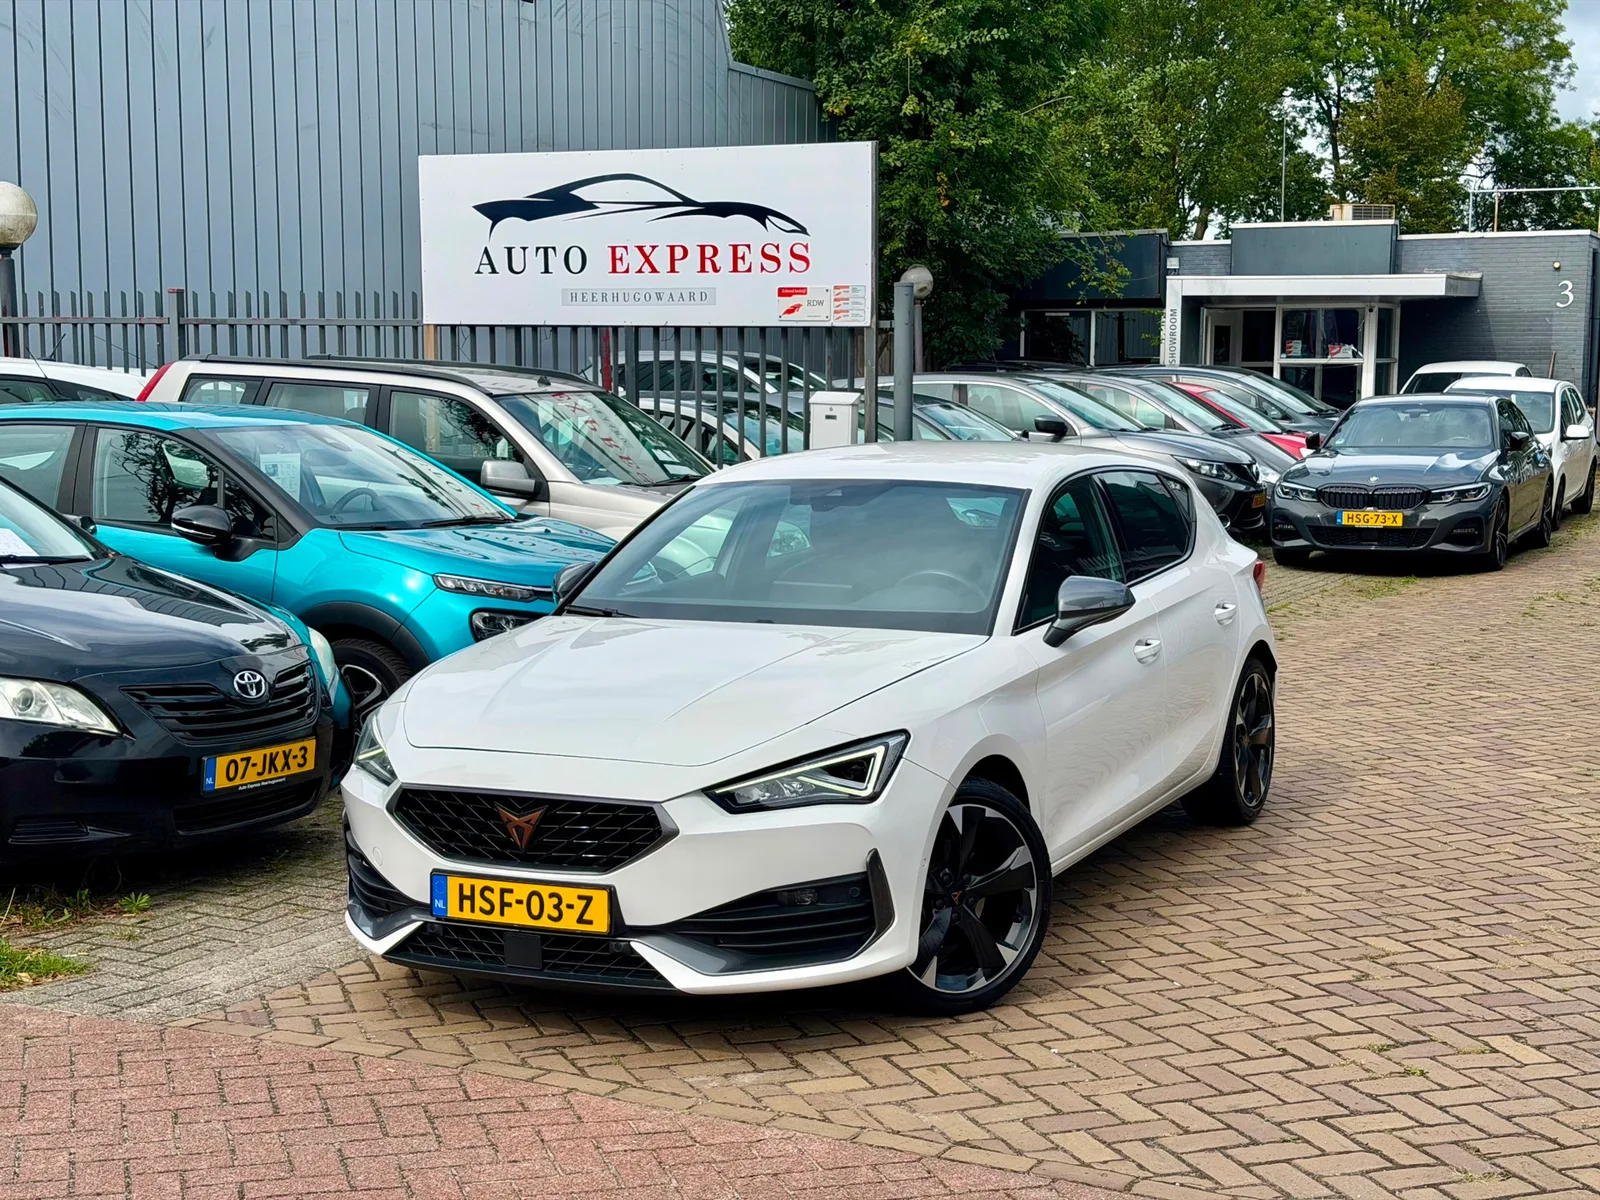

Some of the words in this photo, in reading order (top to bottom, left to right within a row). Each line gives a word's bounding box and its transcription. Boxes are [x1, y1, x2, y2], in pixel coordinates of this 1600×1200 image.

[474, 245, 588, 275] AUTO
[607, 242, 811, 275] EXPRESS
[570, 290, 708, 303] HEERHUGOWAARD
[806, 299, 825, 307] RDW
[1556, 280, 1574, 308] 3
[1168, 308, 1178, 365] SHOWROOM
[1346, 513, 1398, 524] HSG-73-X
[225, 745, 308, 782] 07-JKX-3
[205, 777, 214, 785] NL
[434, 899, 446, 909] NL
[458, 883, 594, 925] HSF-03-Z
